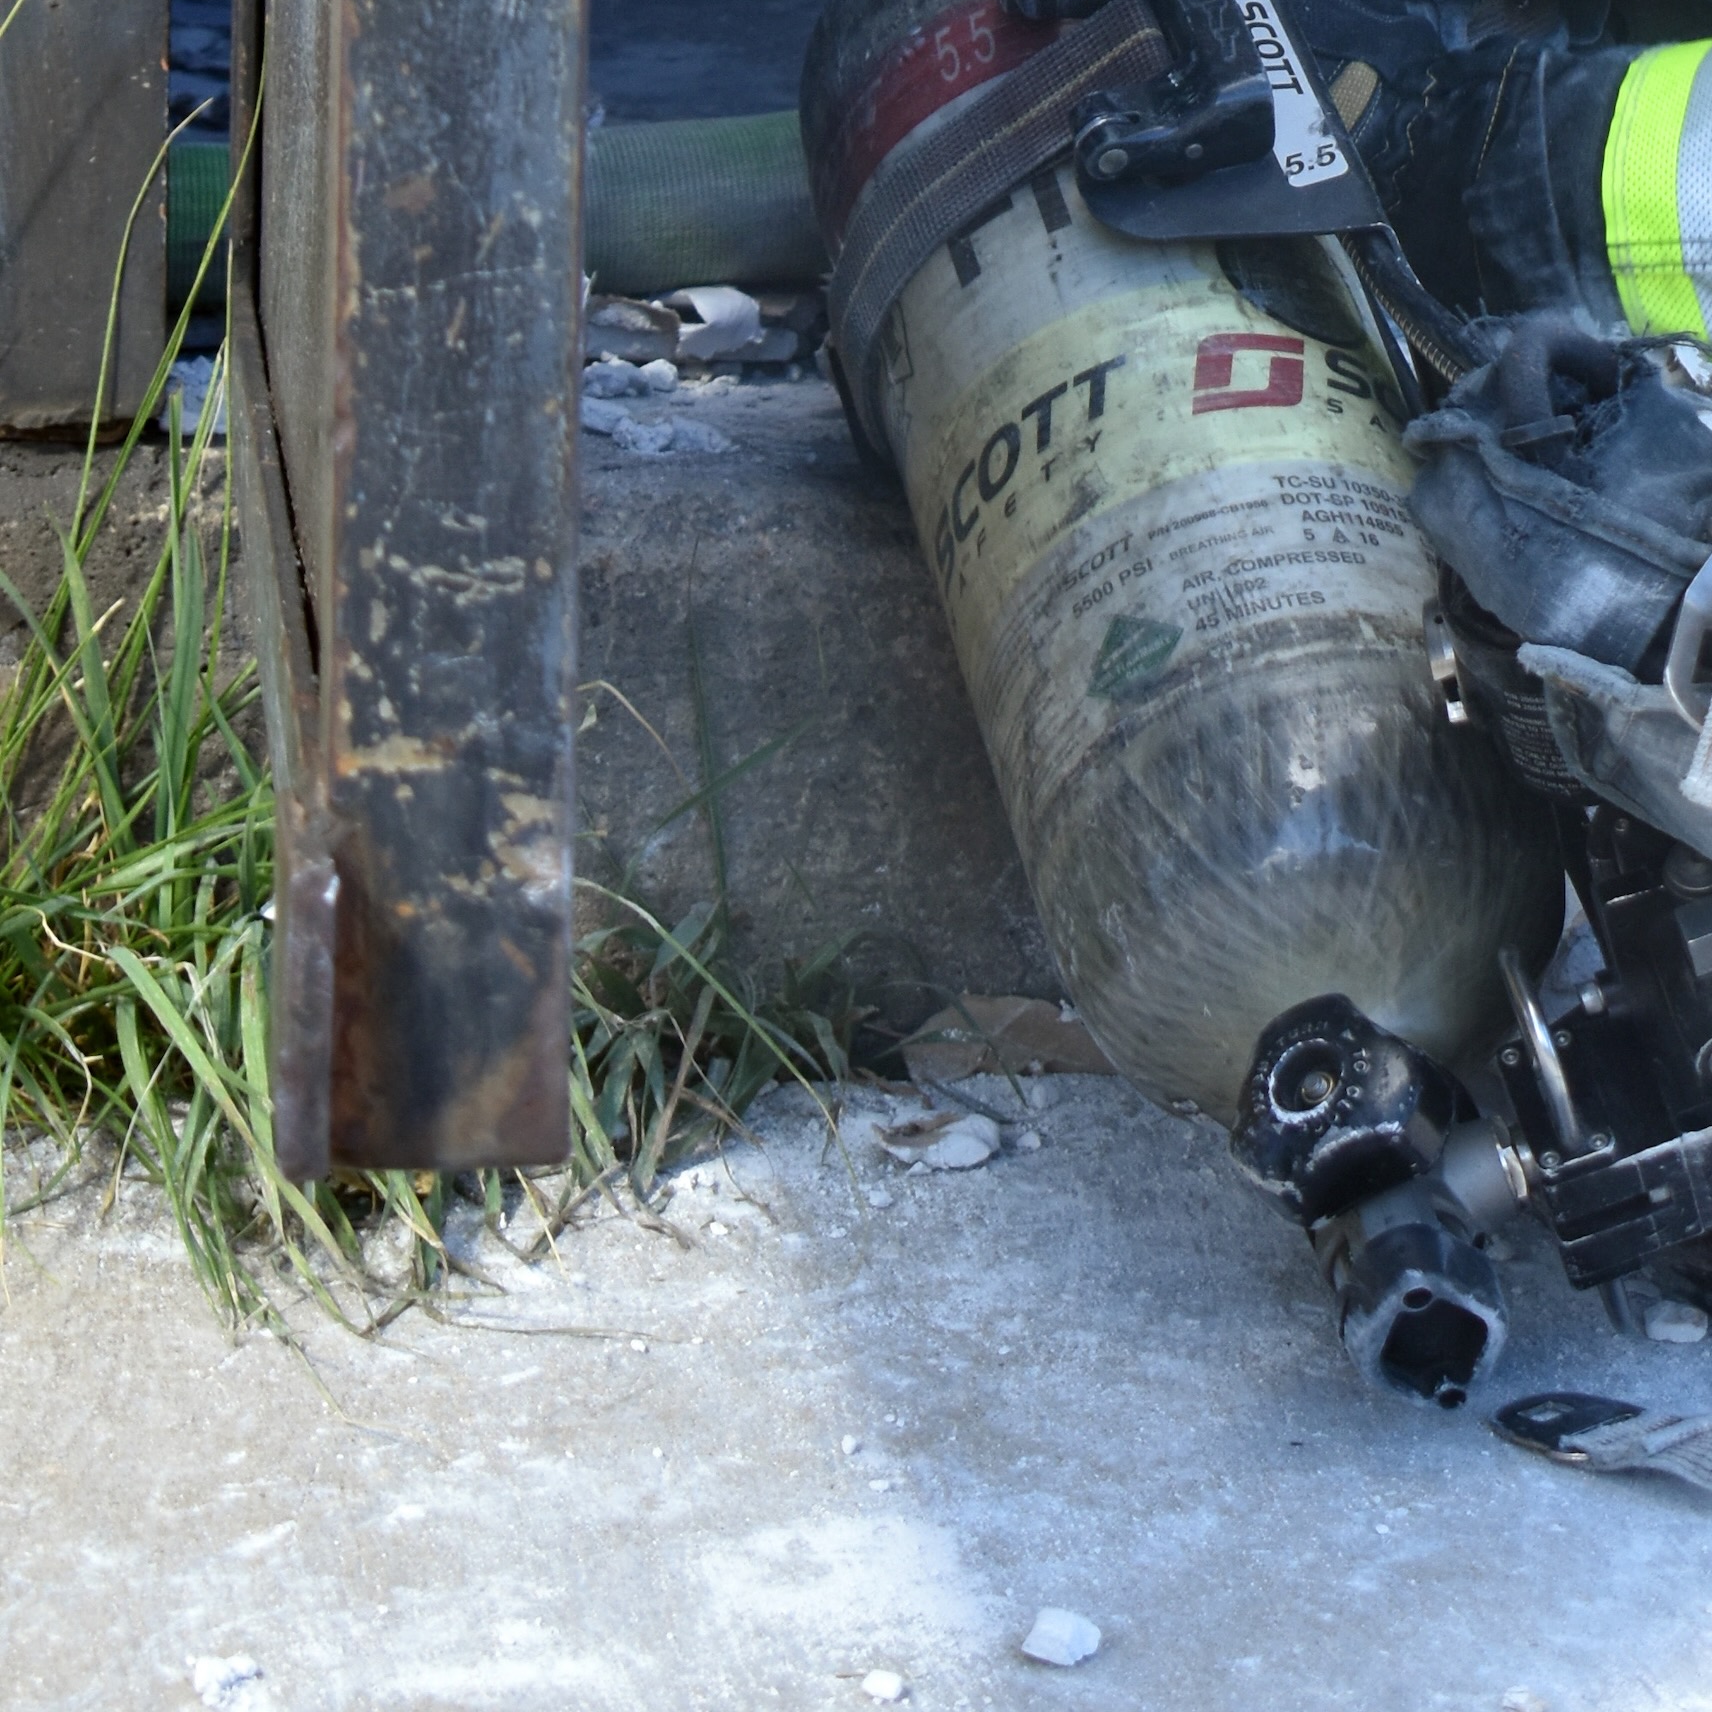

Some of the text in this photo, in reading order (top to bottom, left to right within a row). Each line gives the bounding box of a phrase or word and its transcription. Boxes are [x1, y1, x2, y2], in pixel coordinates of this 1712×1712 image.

[934, 9, 996, 83] 5.5
[1242, 0, 1304, 95] SCOTT
[1285, 143, 1337, 177] 5.5
[934, 354, 1126, 597] SCOTT
[1225, 550, 1367, 576] COMPRESSED
[1358, 531, 1380, 547] 16
[1072, 559, 1153, 620] 5500 PSI
[1195, 589, 1326, 632] 45 MINUTES
